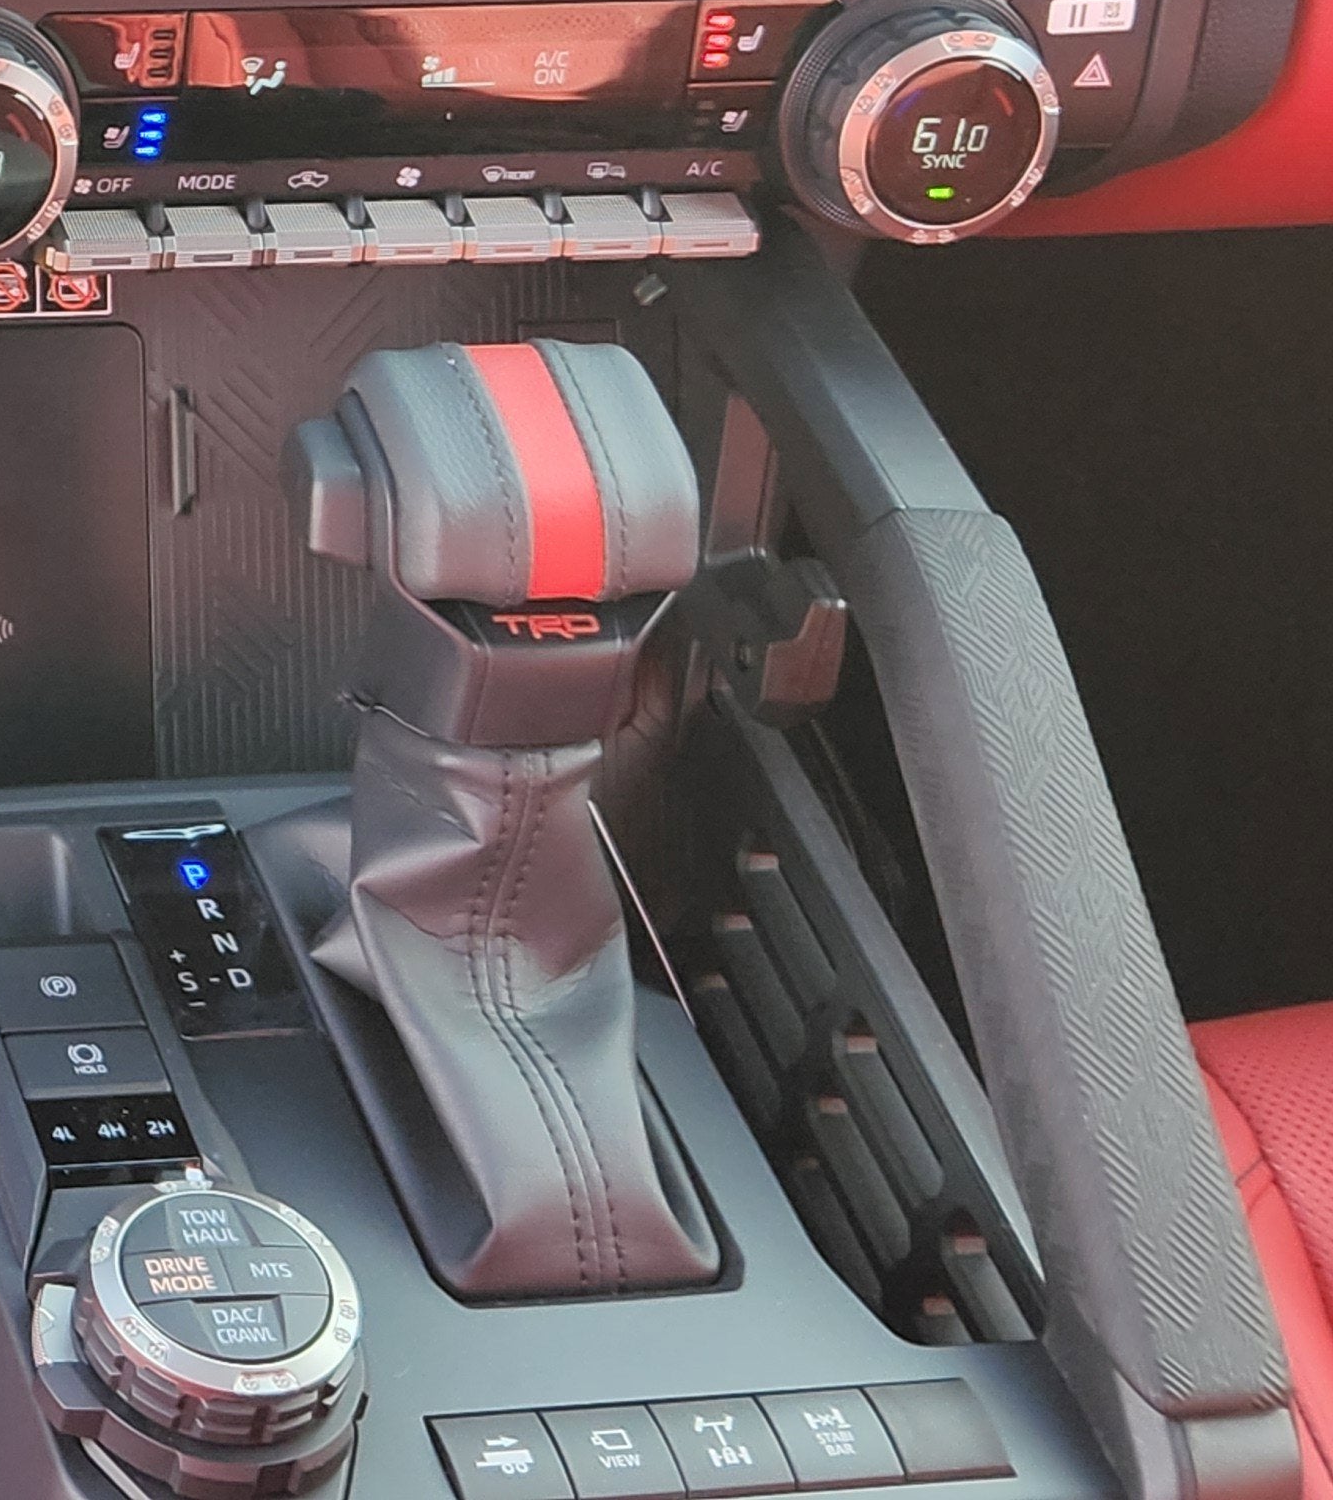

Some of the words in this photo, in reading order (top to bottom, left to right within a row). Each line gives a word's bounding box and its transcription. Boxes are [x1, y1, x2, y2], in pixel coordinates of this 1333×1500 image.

[534, 50, 569, 68] A/C
[534, 69, 566, 85] ON
[686, 160, 723, 177] A/C
[921, 153, 968, 170] SYNC
[96, 177, 133, 193] OFF
[178, 173, 236, 190] MODE
[491, 613, 601, 639] TRD
[181, 862, 209, 889] P
[196, 898, 225, 921] R
[211, 932, 240, 954] N
[177, 971, 200, 992] S
[226, 968, 253, 989] D
[73, 1064, 108, 1075] HOLD
[52, 1125, 77, 1143] 4L
[97, 1121, 127, 1140] 4H
[146, 1119, 177, 1137] 2H
[179, 1208, 230, 1226] TOW
[182, 1227, 239, 1245] HAUL
[144, 1256, 210, 1275] DRIVE
[249, 1261, 293, 1279] MTS
[150, 1274, 218, 1295] MODE
[211, 1306, 265, 1325] DAC/
[216, 1326, 277, 1345] CRAWL
[825, 1443, 857, 1457] BAR
[598, 1452, 642, 1469] VIEW
